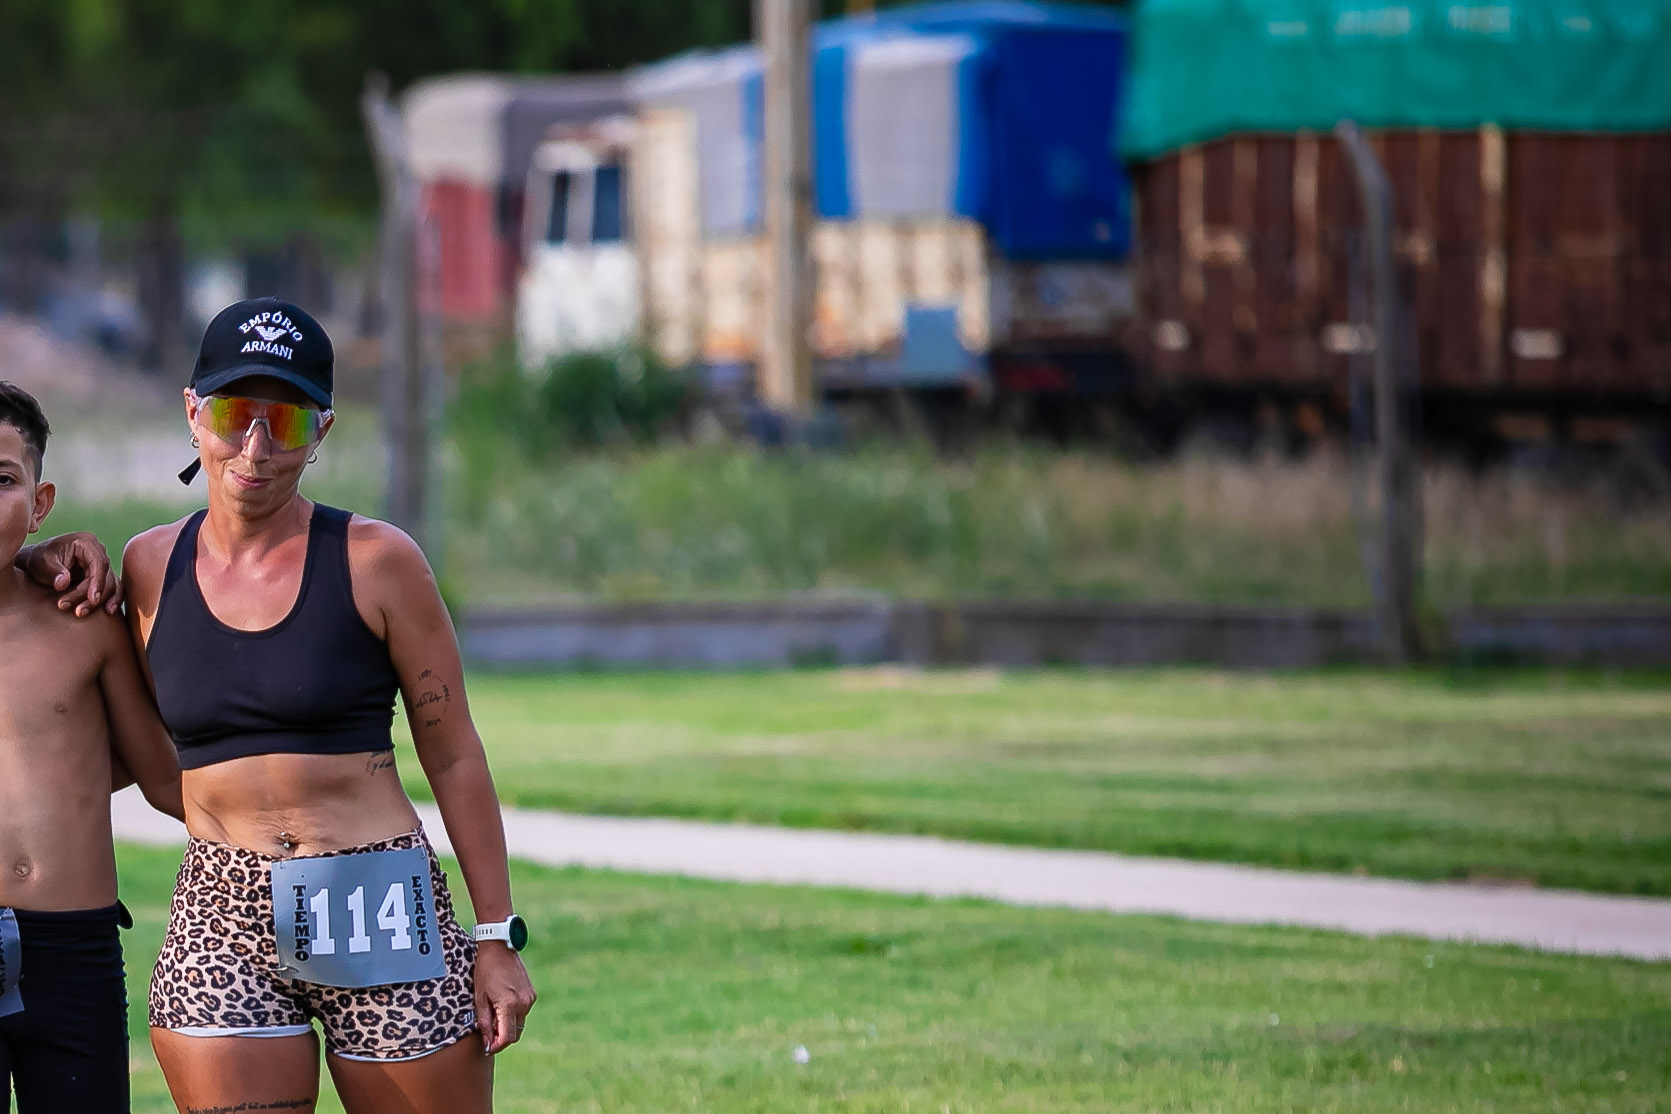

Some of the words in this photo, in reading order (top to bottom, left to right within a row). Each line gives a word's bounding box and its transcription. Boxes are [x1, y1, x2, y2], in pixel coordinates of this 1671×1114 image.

[240, 341, 294, 360] ARMANI
[292, 884, 310, 961] TIEMPO
[310, 882, 412, 955] 114
[411, 875, 431, 955] EXACTO
